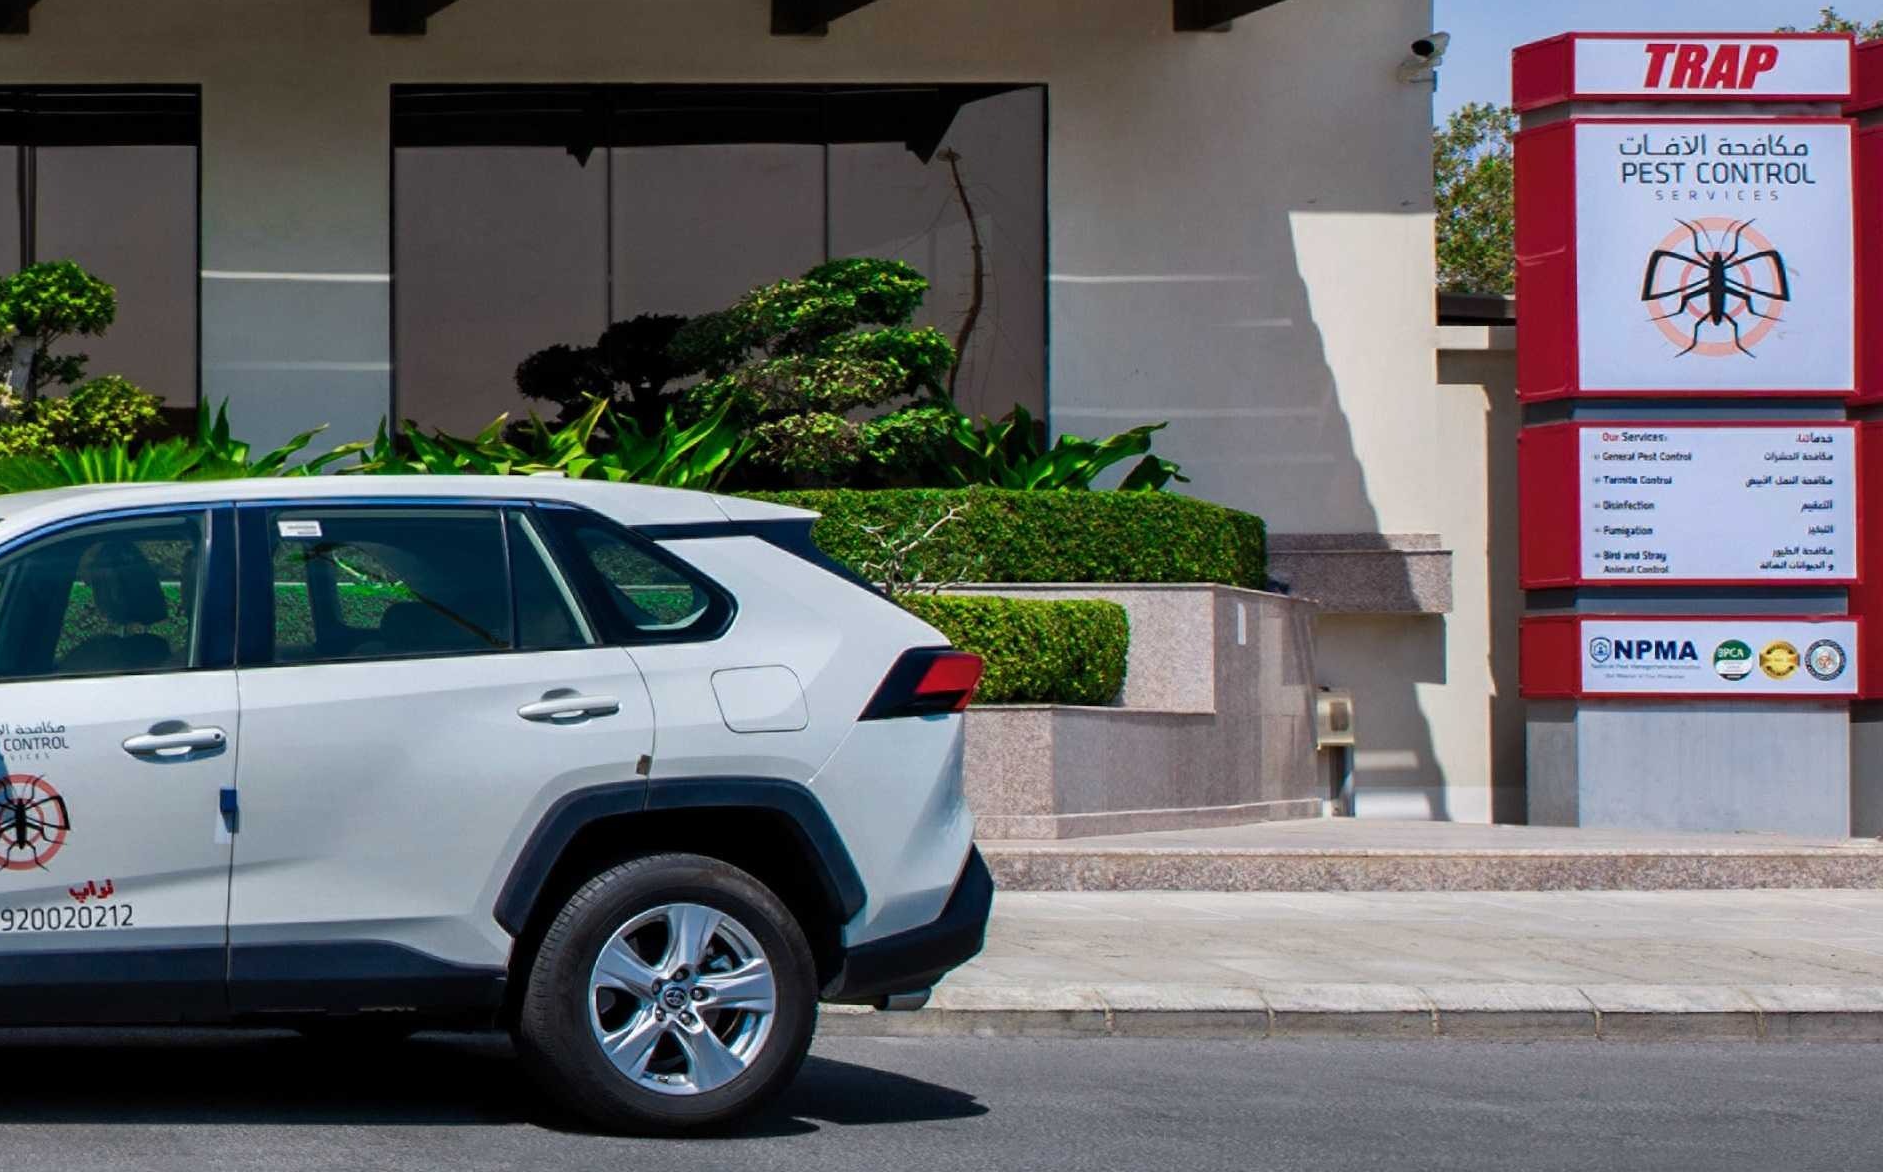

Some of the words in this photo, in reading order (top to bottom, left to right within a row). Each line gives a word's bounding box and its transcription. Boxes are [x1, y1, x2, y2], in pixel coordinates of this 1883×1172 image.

[1643, 43, 1780, 90] TRAP
[1718, 133, 1809, 157] مكافحة
[1622, 162, 1686, 184] PEST
[1696, 162, 1816, 185] CONTROL
[1655, 189, 1780, 201] SERVICES
[1602, 431, 1619, 443] Our
[1602, 451, 1635, 462] General
[1637, 451, 1657, 462] Pest
[1659, 451, 1692, 462] Control
[1614, 639, 1699, 661] NPMA
[3, 735, 70, 752] CONTROL
[0, 904, 134, 932] 920020212
